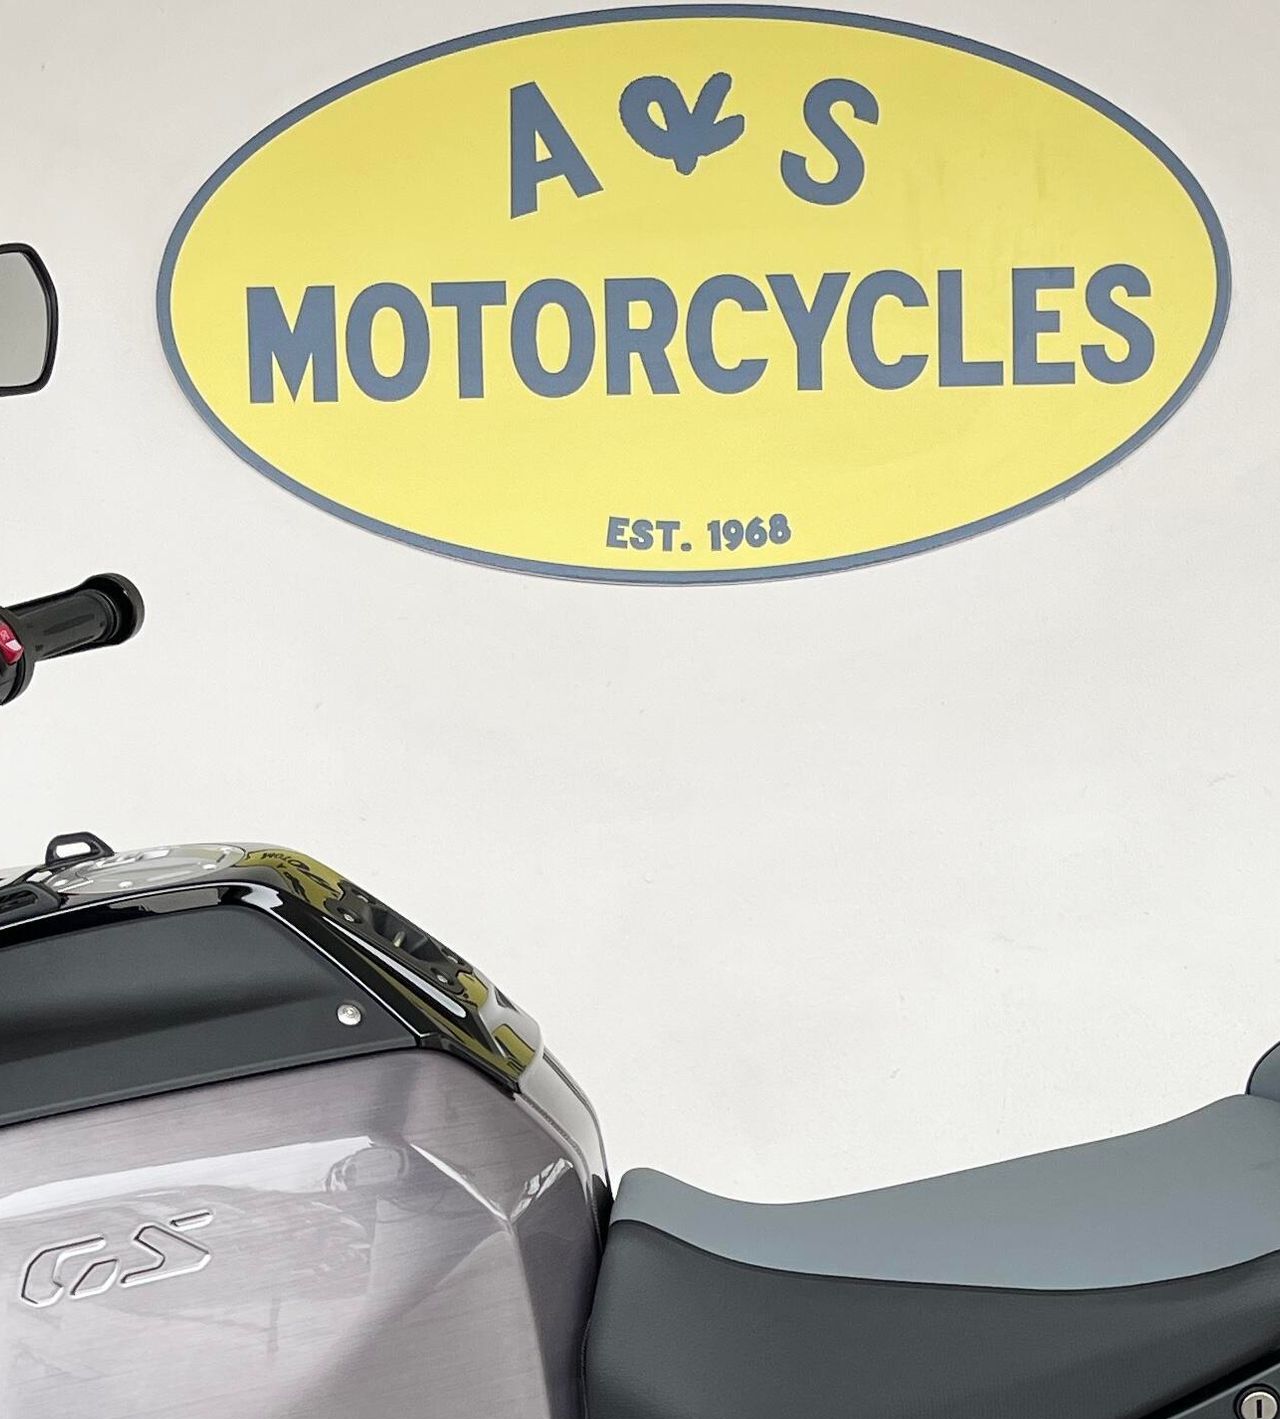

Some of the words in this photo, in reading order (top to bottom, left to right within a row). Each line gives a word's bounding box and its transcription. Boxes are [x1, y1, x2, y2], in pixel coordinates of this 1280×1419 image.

[509, 81, 603, 219] A
[780, 78, 880, 206] S
[246, 263, 1155, 404] MOTORCYCLES
[606, 516, 693, 553] EST.
[707, 513, 792, 552] 1968
[20, 1208, 214, 1308] GS
